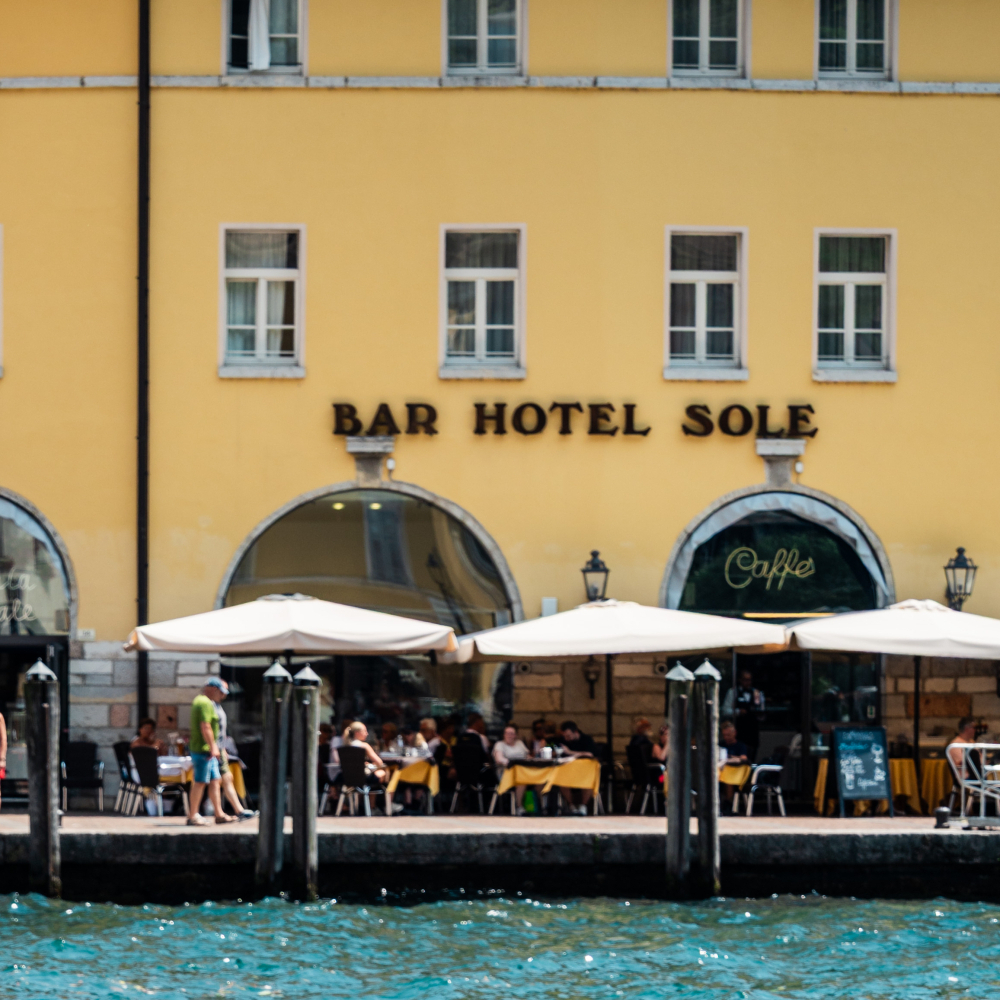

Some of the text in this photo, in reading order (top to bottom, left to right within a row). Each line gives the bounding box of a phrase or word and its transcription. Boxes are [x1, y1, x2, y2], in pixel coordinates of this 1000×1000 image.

[332, 402, 819, 439] BAR HOTEL SOLE
